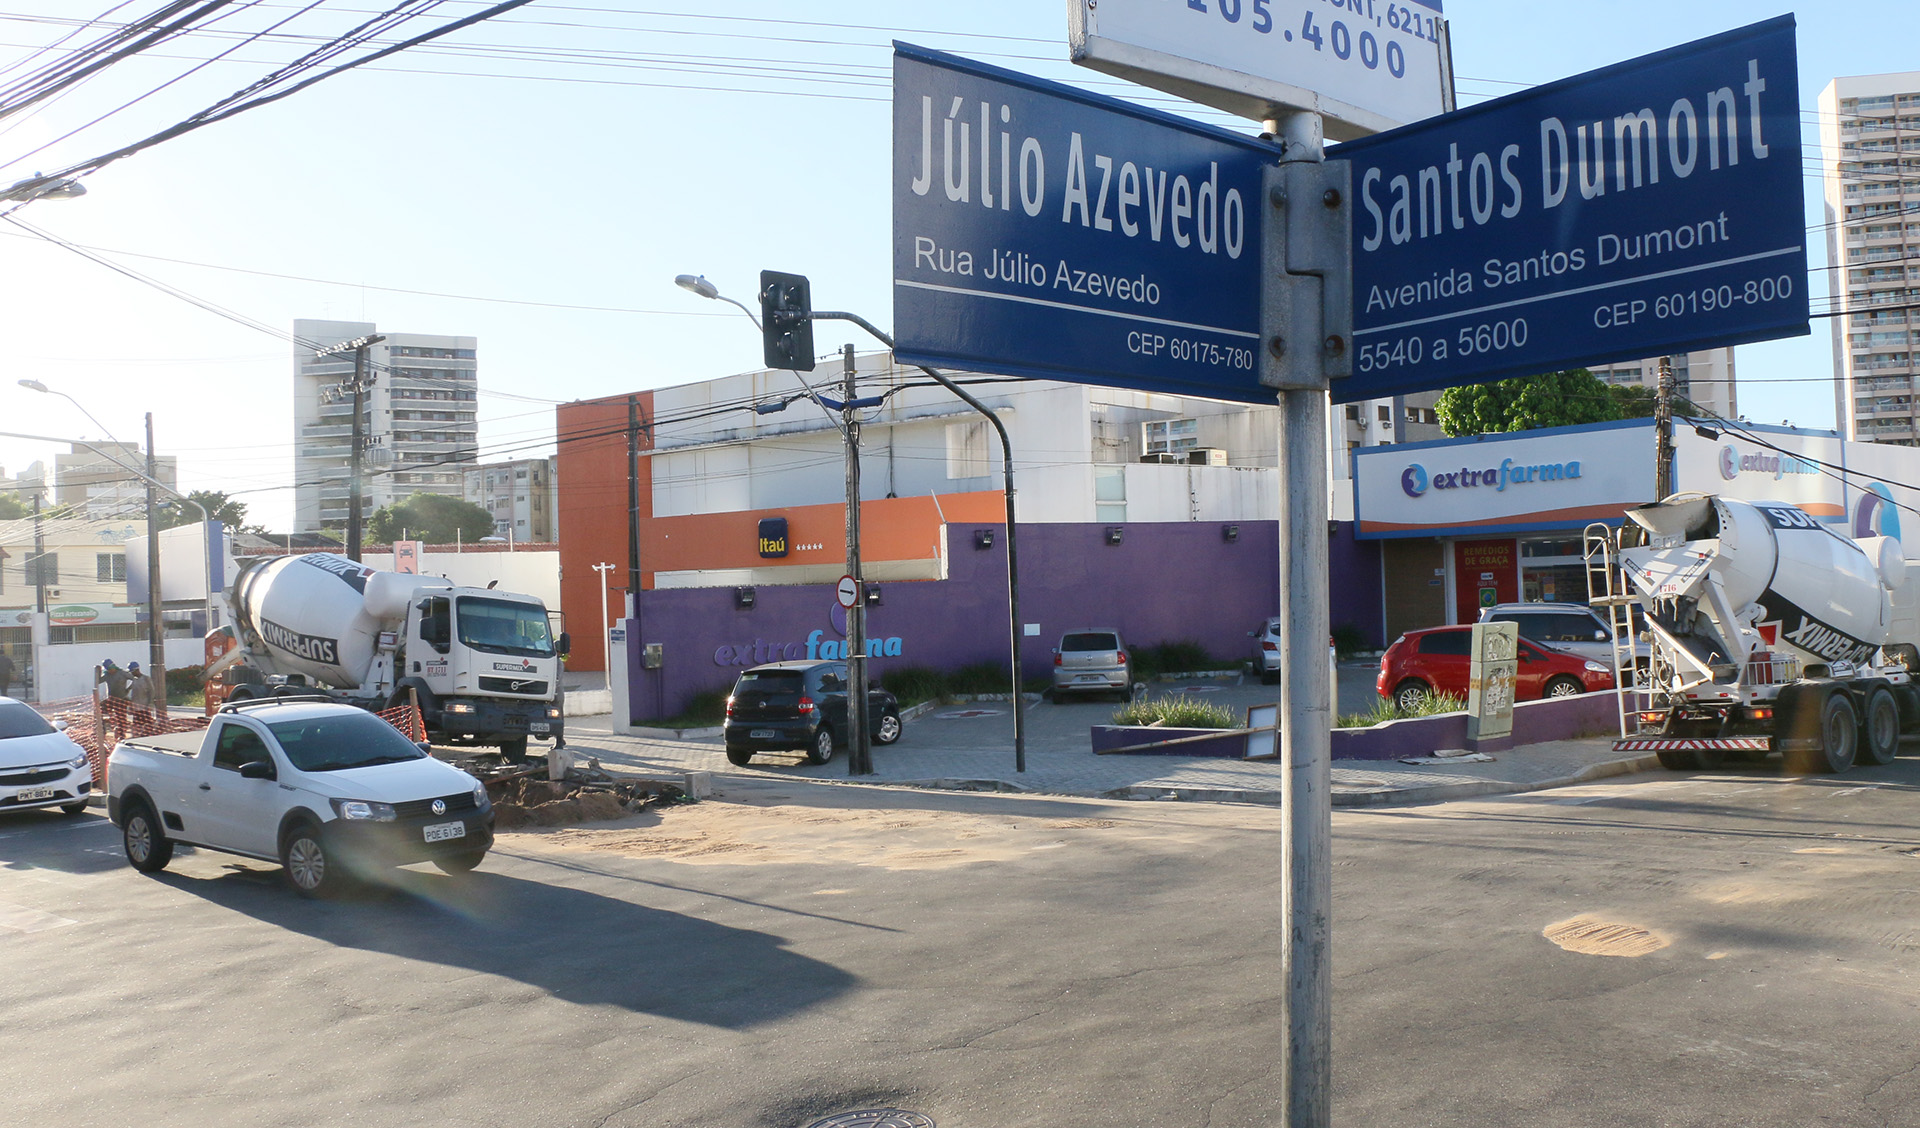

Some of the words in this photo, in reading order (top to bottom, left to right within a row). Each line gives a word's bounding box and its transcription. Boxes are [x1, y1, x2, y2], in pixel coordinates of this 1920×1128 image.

[1387, 3, 1438, 44] 6211
[1362, 143, 1522, 252] Santos
[1540, 59, 1769, 209] Dumont
[911, 96, 1045, 217] Júlio
[1062, 132, 1244, 259] Azevedo
[915, 236, 973, 276] Rua
[984, 248, 1047, 287] Júlio
[1053, 260, 1160, 305] Azevedo
[1366, 268, 1473, 313] Avenida
[1483, 244, 1586, 288] Santos
[1598, 211, 1729, 265] Dumont
[1594, 300, 1647, 328] CEP
[1655, 275, 1793, 319] 60190-800
[1127, 331, 1166, 356] CEP
[1171, 338, 1253, 370] 60175-780
[1359, 335, 1422, 372] 5540
[1432, 339, 1447, 360] a
[1458, 318, 1528, 356] 5600
[1433, 458, 1581, 492] extrafarma
[759, 537, 785, 553] Itaú
[1465, 557, 1476, 566] DE
[1659, 584, 1677, 592] 1716
[261, 621, 335, 662] SUPERMIX
